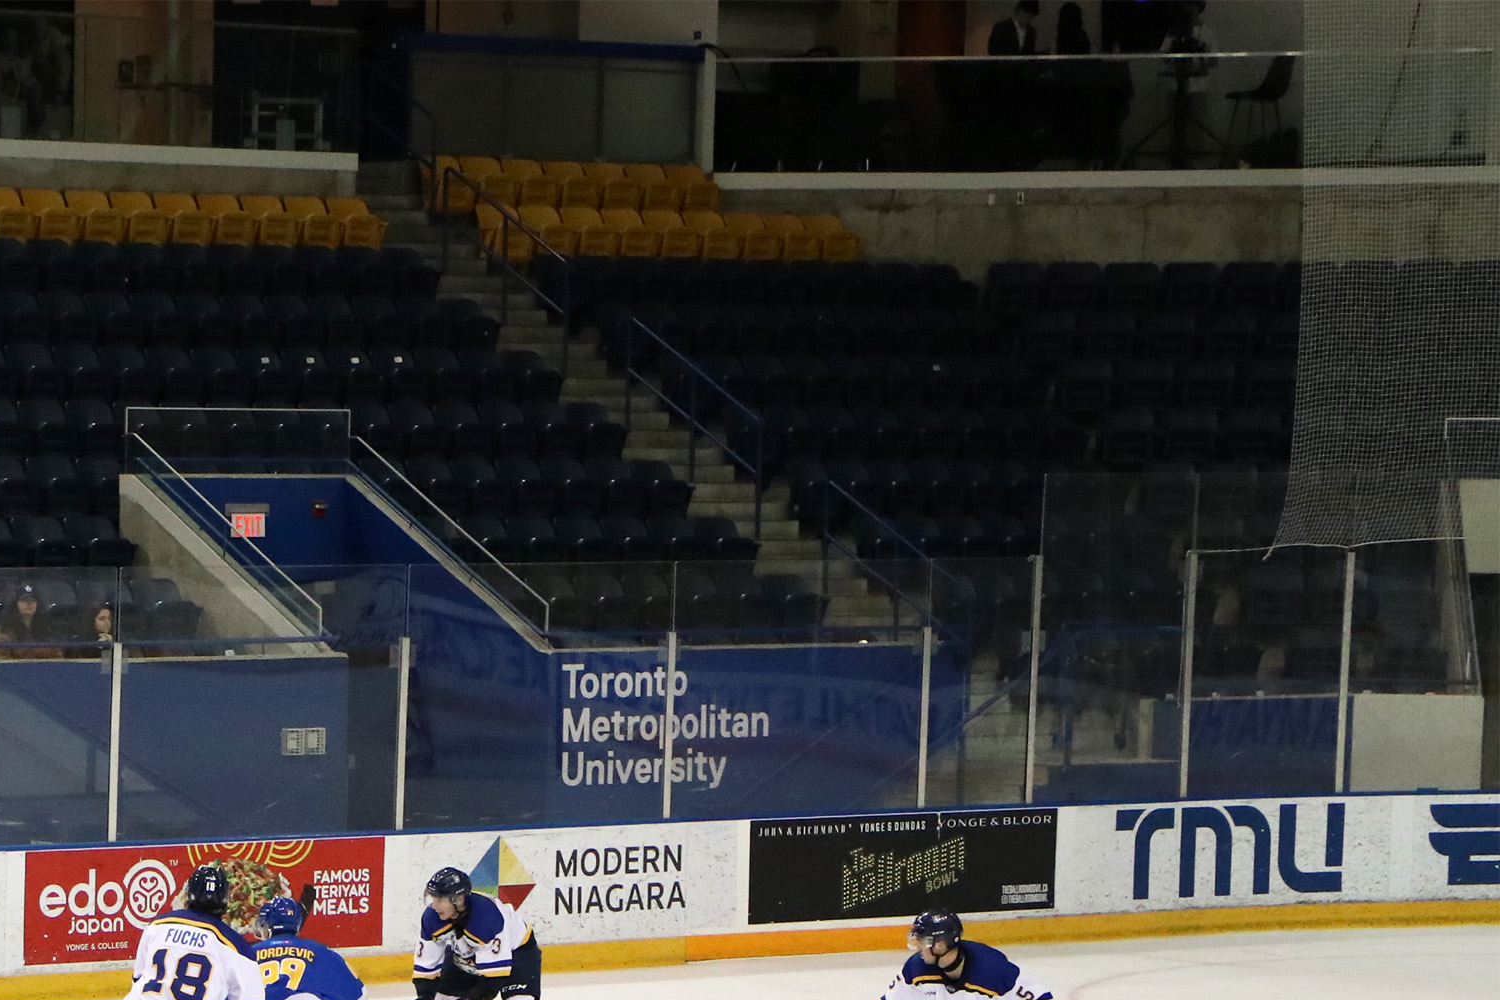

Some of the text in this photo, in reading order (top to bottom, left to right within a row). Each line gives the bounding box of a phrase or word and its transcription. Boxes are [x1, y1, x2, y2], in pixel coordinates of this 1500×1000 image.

[235, 515, 263, 537] EXIT
[561, 663, 688, 699] Toronto
[562, 703, 770, 750] Metropolitan
[561, 747, 727, 789] University
[758, 826, 783, 837] JOHN
[786, 826, 793, 836] &
[859, 822, 885, 833] YONGE
[894, 820, 926, 832] DUNDAS
[938, 815, 1052, 829] YONGE & BLOOR
[555, 844, 683, 878] MODERN
[1115, 803, 1346, 900] TMU
[313, 868, 370, 884] FAMOUS
[925, 870, 959, 894] BOWL
[38, 868, 125, 918] edo
[205, 881, 216, 892] 18
[313, 882, 370, 899] TERIYAKI
[313, 897, 370, 916] MEALS
[554, 881, 686, 916] NIAGARA
[67, 917, 124, 936] japan
[65, 941, 129, 951] YONGE & COLLEGE
[164, 928, 208, 948] FUCHS
[491, 938, 502, 955] 3
[501, 983, 528, 993] CCM
